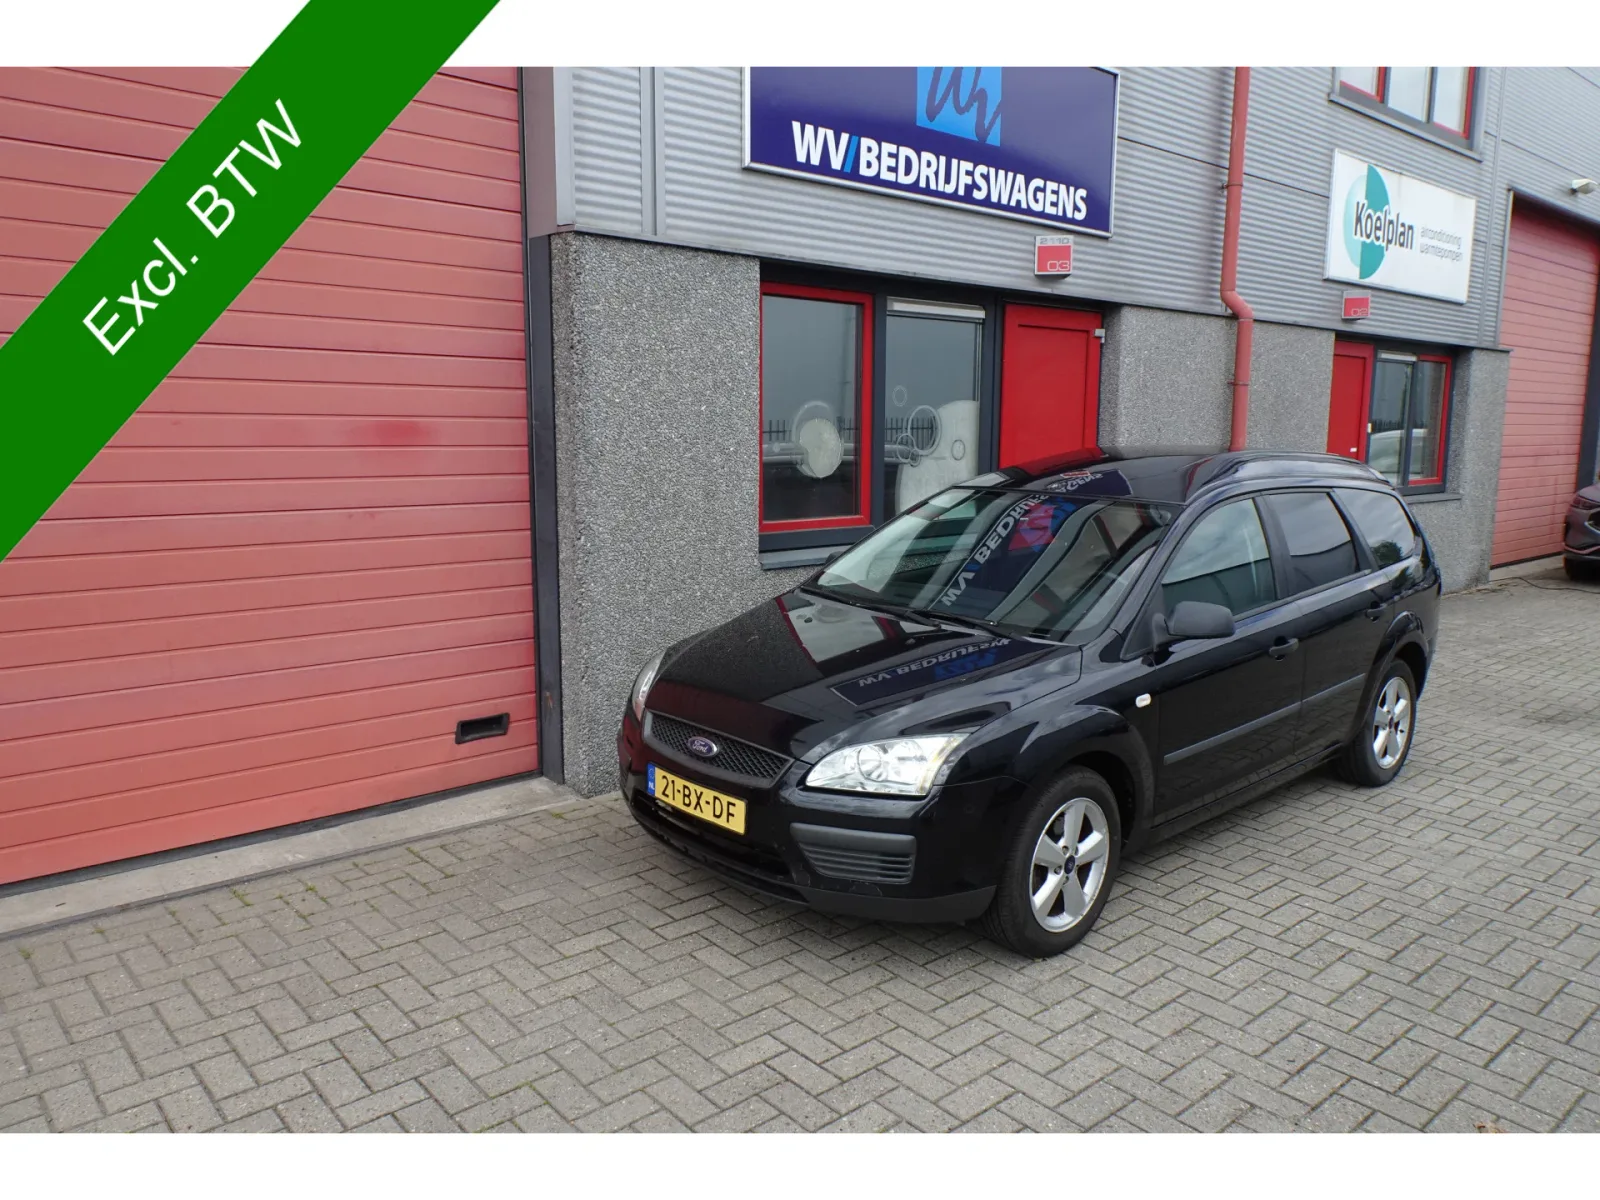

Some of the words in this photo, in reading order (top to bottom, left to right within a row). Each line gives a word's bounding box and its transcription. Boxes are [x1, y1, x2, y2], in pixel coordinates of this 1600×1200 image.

[1354, 201, 1415, 252] Koelplan
[1047, 260, 1070, 271] 03
[693, 739, 709, 753] Ford
[661, 775, 736, 823] 21-BX-DF
